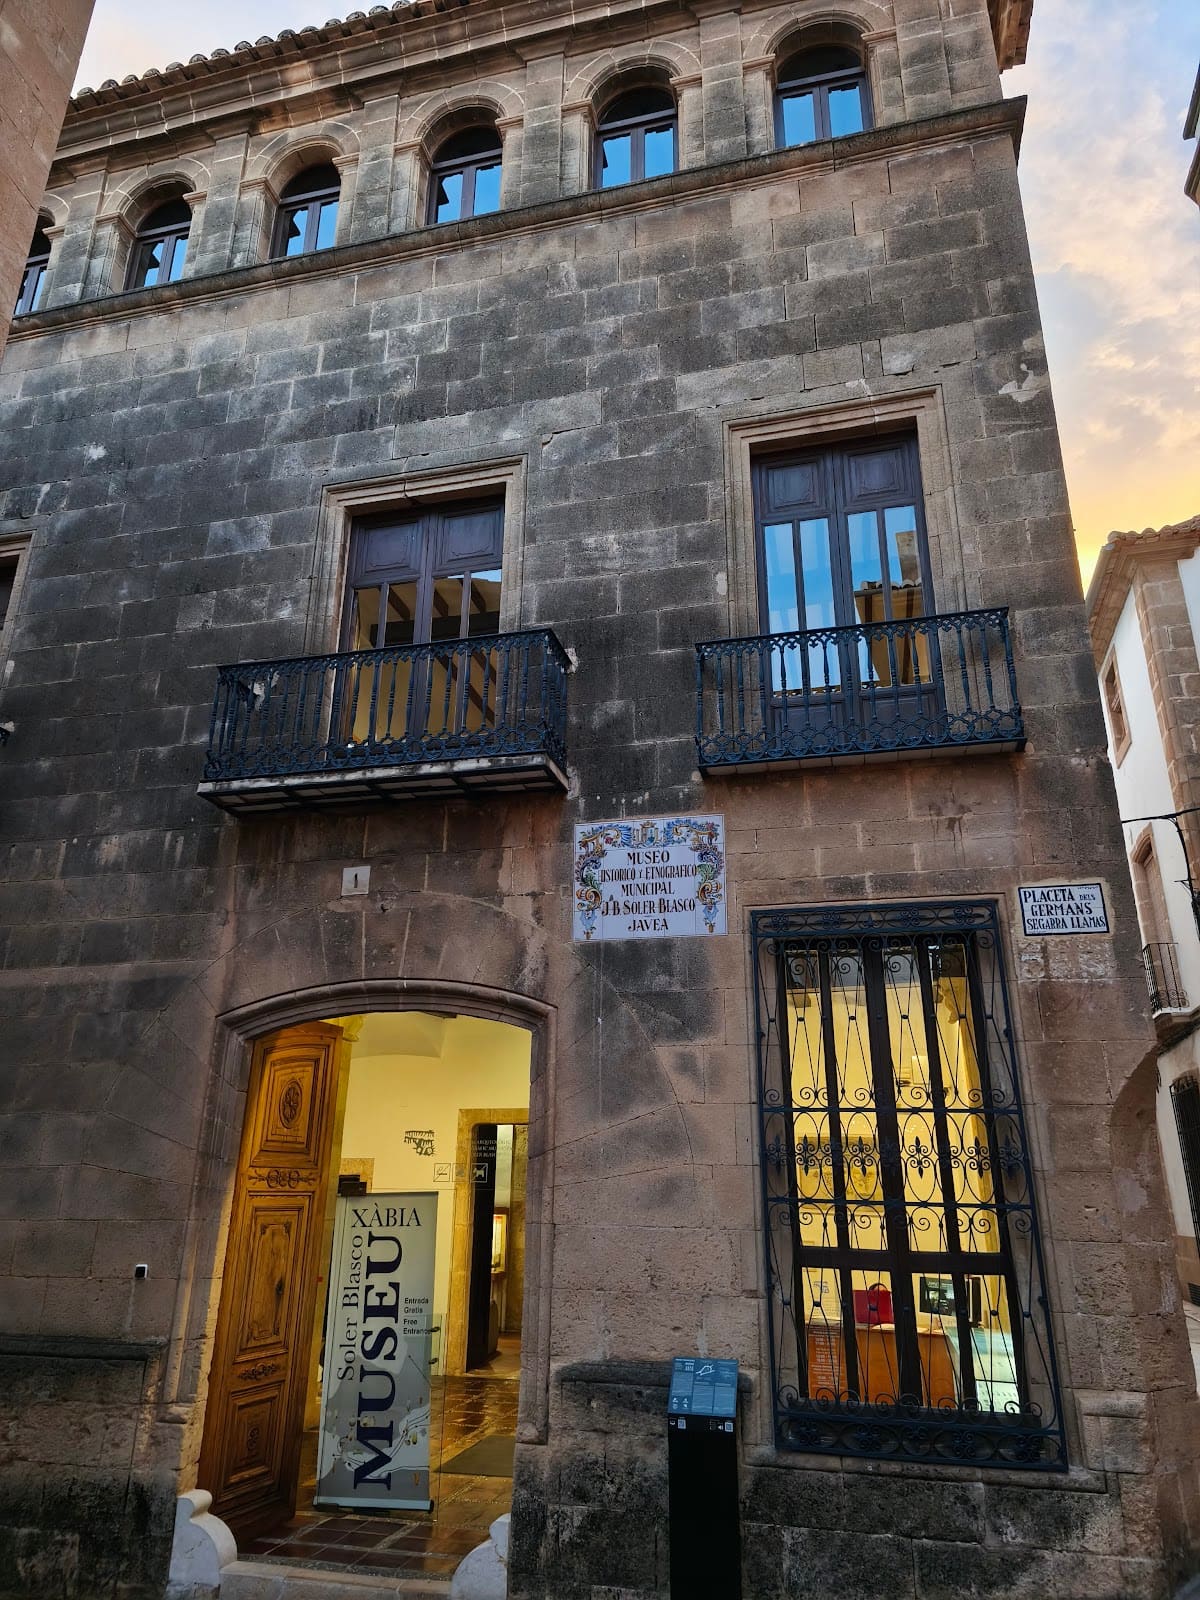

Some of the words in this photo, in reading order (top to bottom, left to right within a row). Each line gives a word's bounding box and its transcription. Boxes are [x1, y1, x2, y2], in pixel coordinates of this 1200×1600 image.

[627, 851, 670, 866] MUSEO
[645, 864, 697, 880] ETNOGRAFICO
[621, 881, 675, 897] MUNICIPAL
[1023, 888, 1075, 903] PLACETA
[623, 899, 656, 915] SOLER
[659, 898, 696, 914] BLASCO
[1031, 902, 1093, 917] GERMANS
[628, 918, 669, 932] JAVEA
[1026, 917, 1068, 930] SEGARRA
[1070, 916, 1106, 929] LLAMAS
[351, 1202, 423, 1229] XÀBIA
[342, 1235, 364, 1310] Blasco
[403, 1305, 423, 1314] Gratis
[403, 1318, 418, 1326] Free
[337, 1318, 358, 1381] Soler
[353, 1230, 403, 1491] MUSEU
